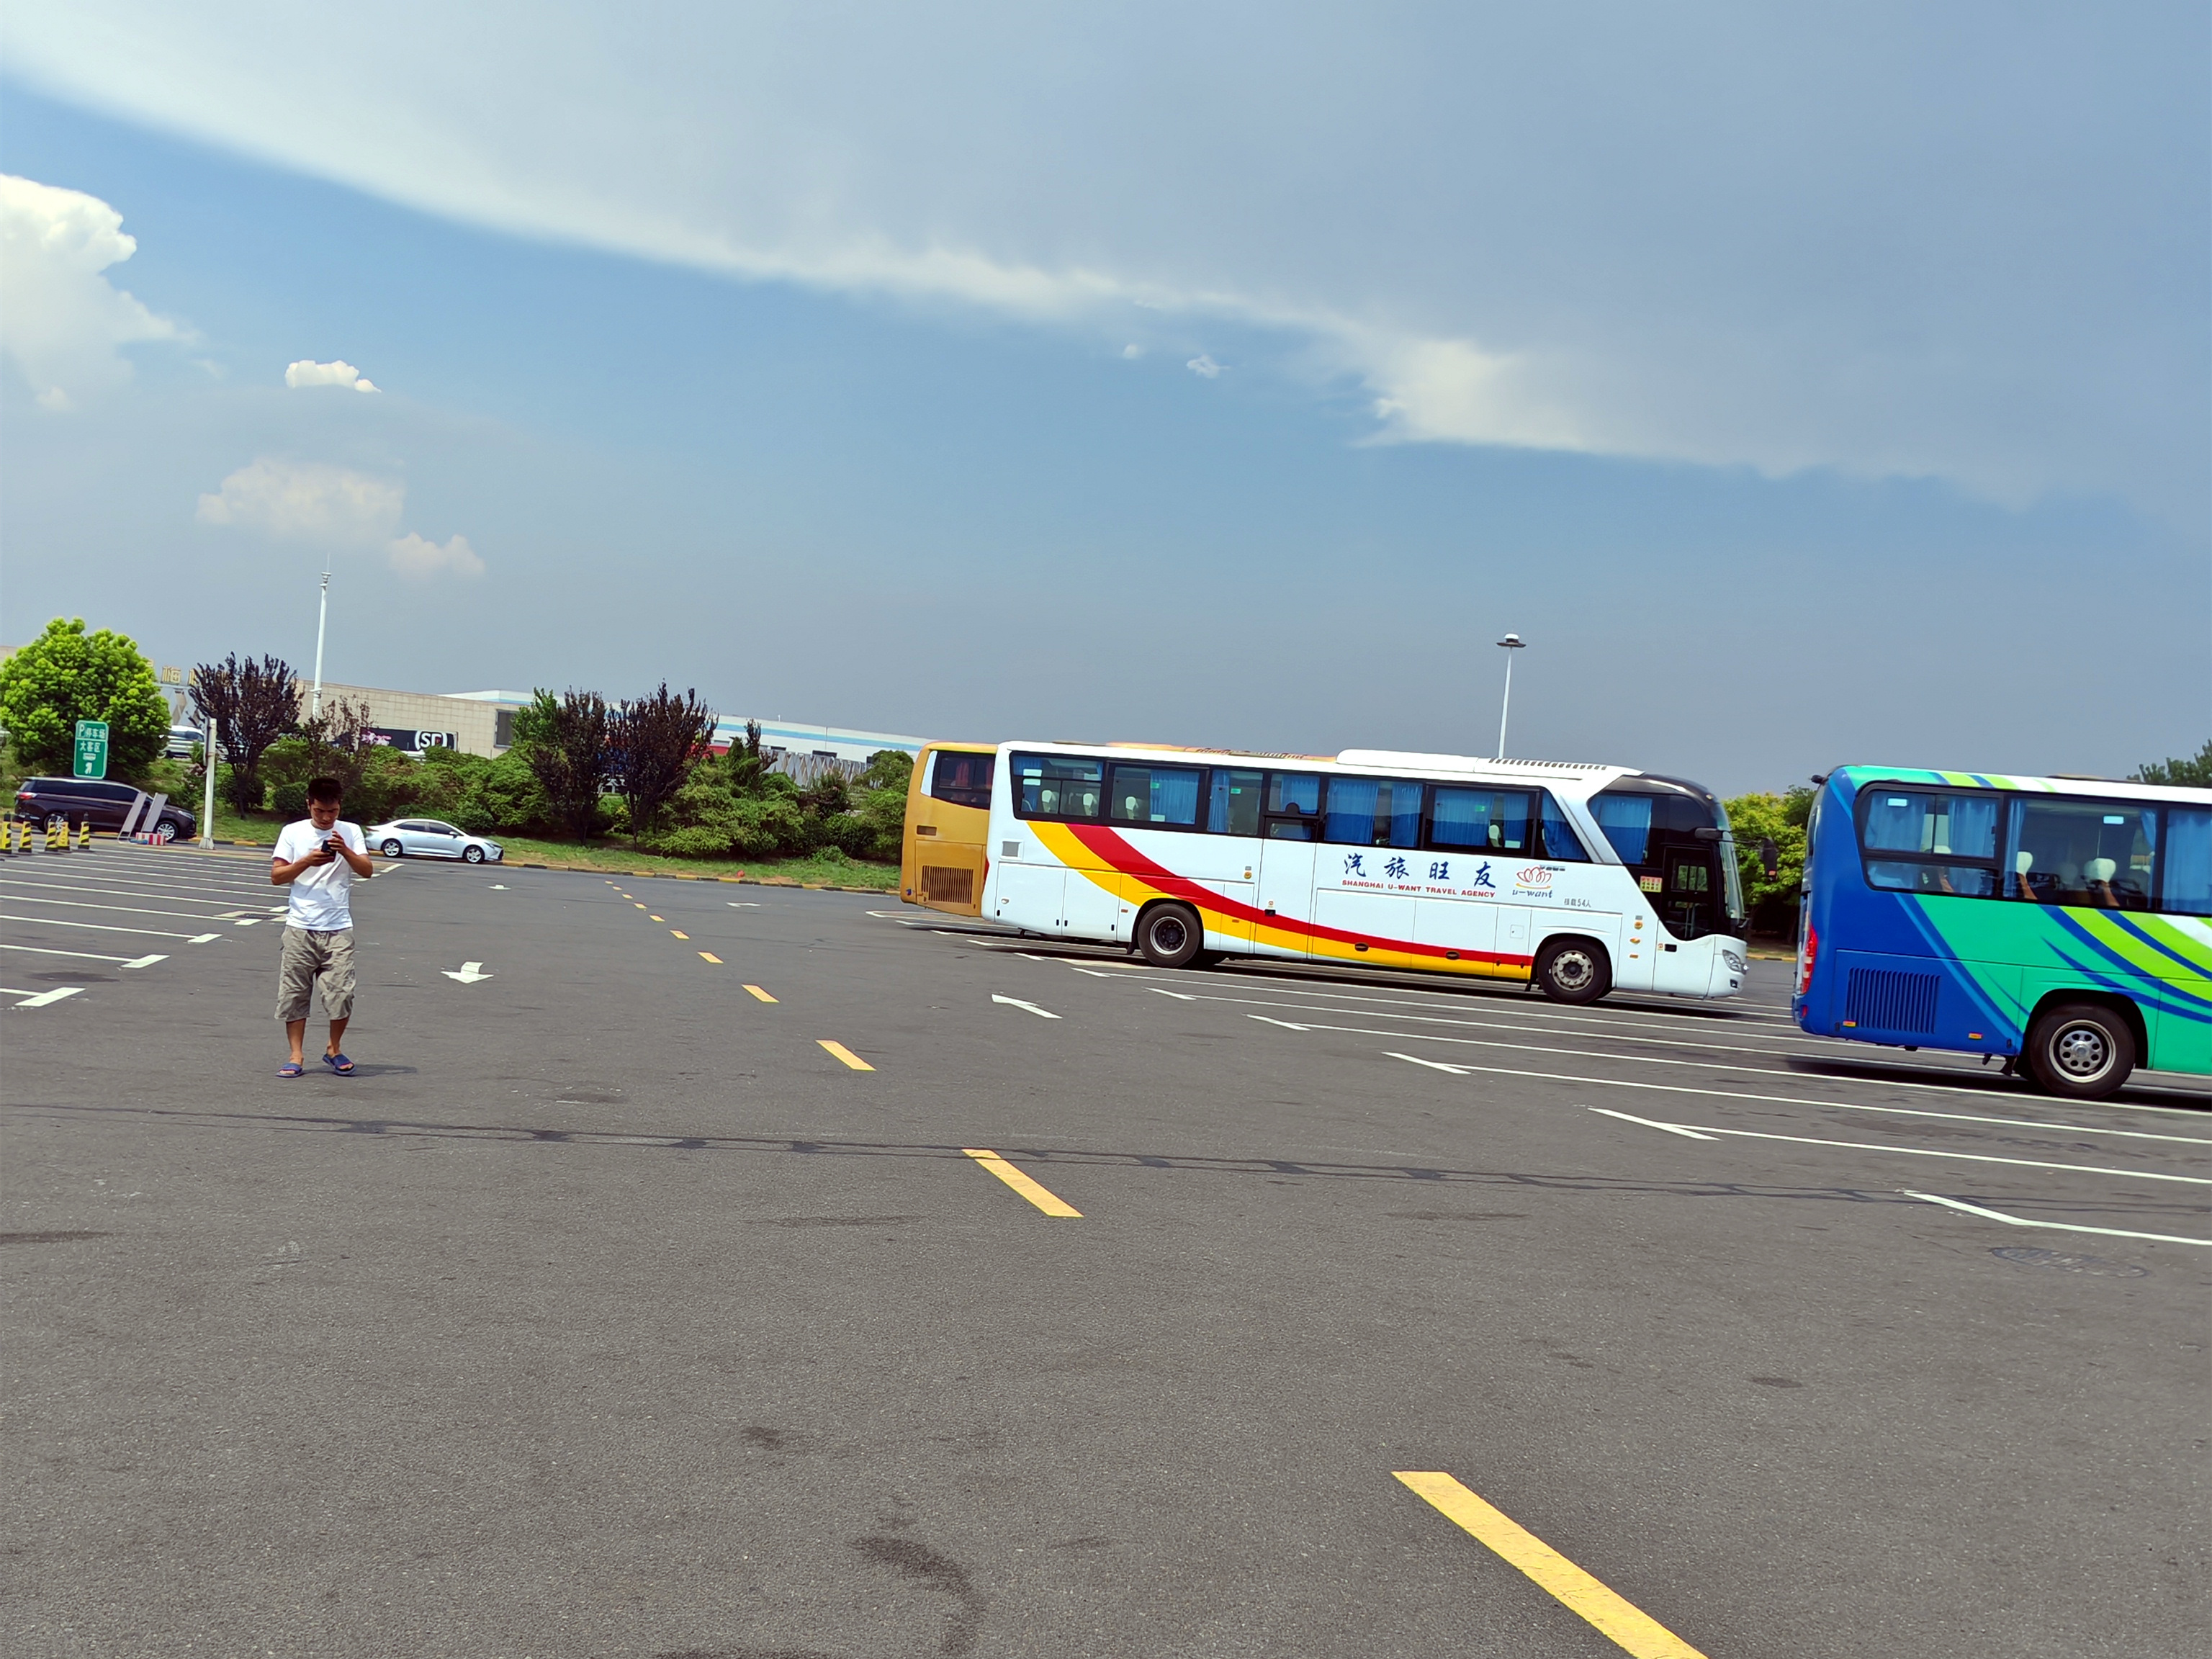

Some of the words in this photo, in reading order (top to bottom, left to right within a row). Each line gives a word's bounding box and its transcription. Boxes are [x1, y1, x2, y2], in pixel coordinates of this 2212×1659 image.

[1341, 879, 1384, 889] SHANGHAI
[1388, 884, 1422, 892] U-WANT
[1425, 886, 1457, 895] TRAVEL
[1460, 889, 1496, 898] AGENCY
